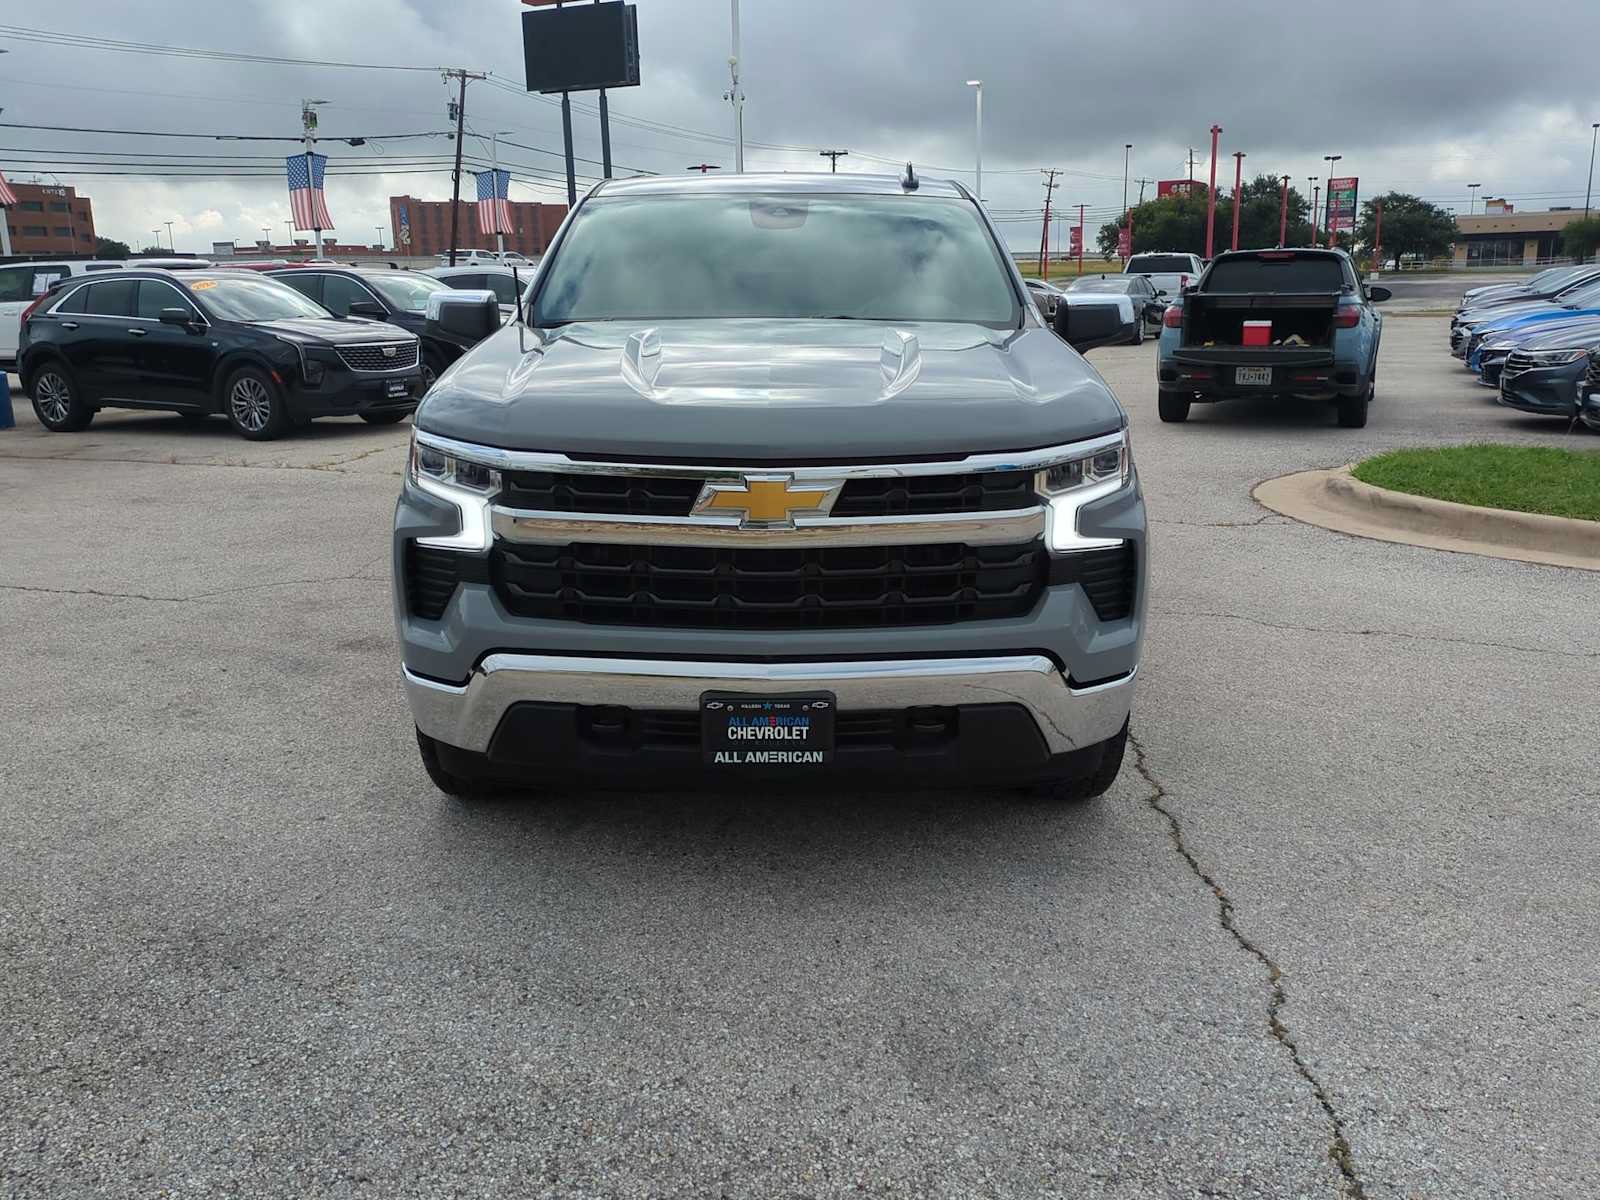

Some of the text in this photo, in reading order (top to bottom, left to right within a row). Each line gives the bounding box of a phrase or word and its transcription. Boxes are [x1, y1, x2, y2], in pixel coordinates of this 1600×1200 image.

[729, 716, 809, 726] ALL AMERICAN
[728, 727, 809, 739] CHEVROLET
[714, 751, 823, 763] ALL AMERICAN
